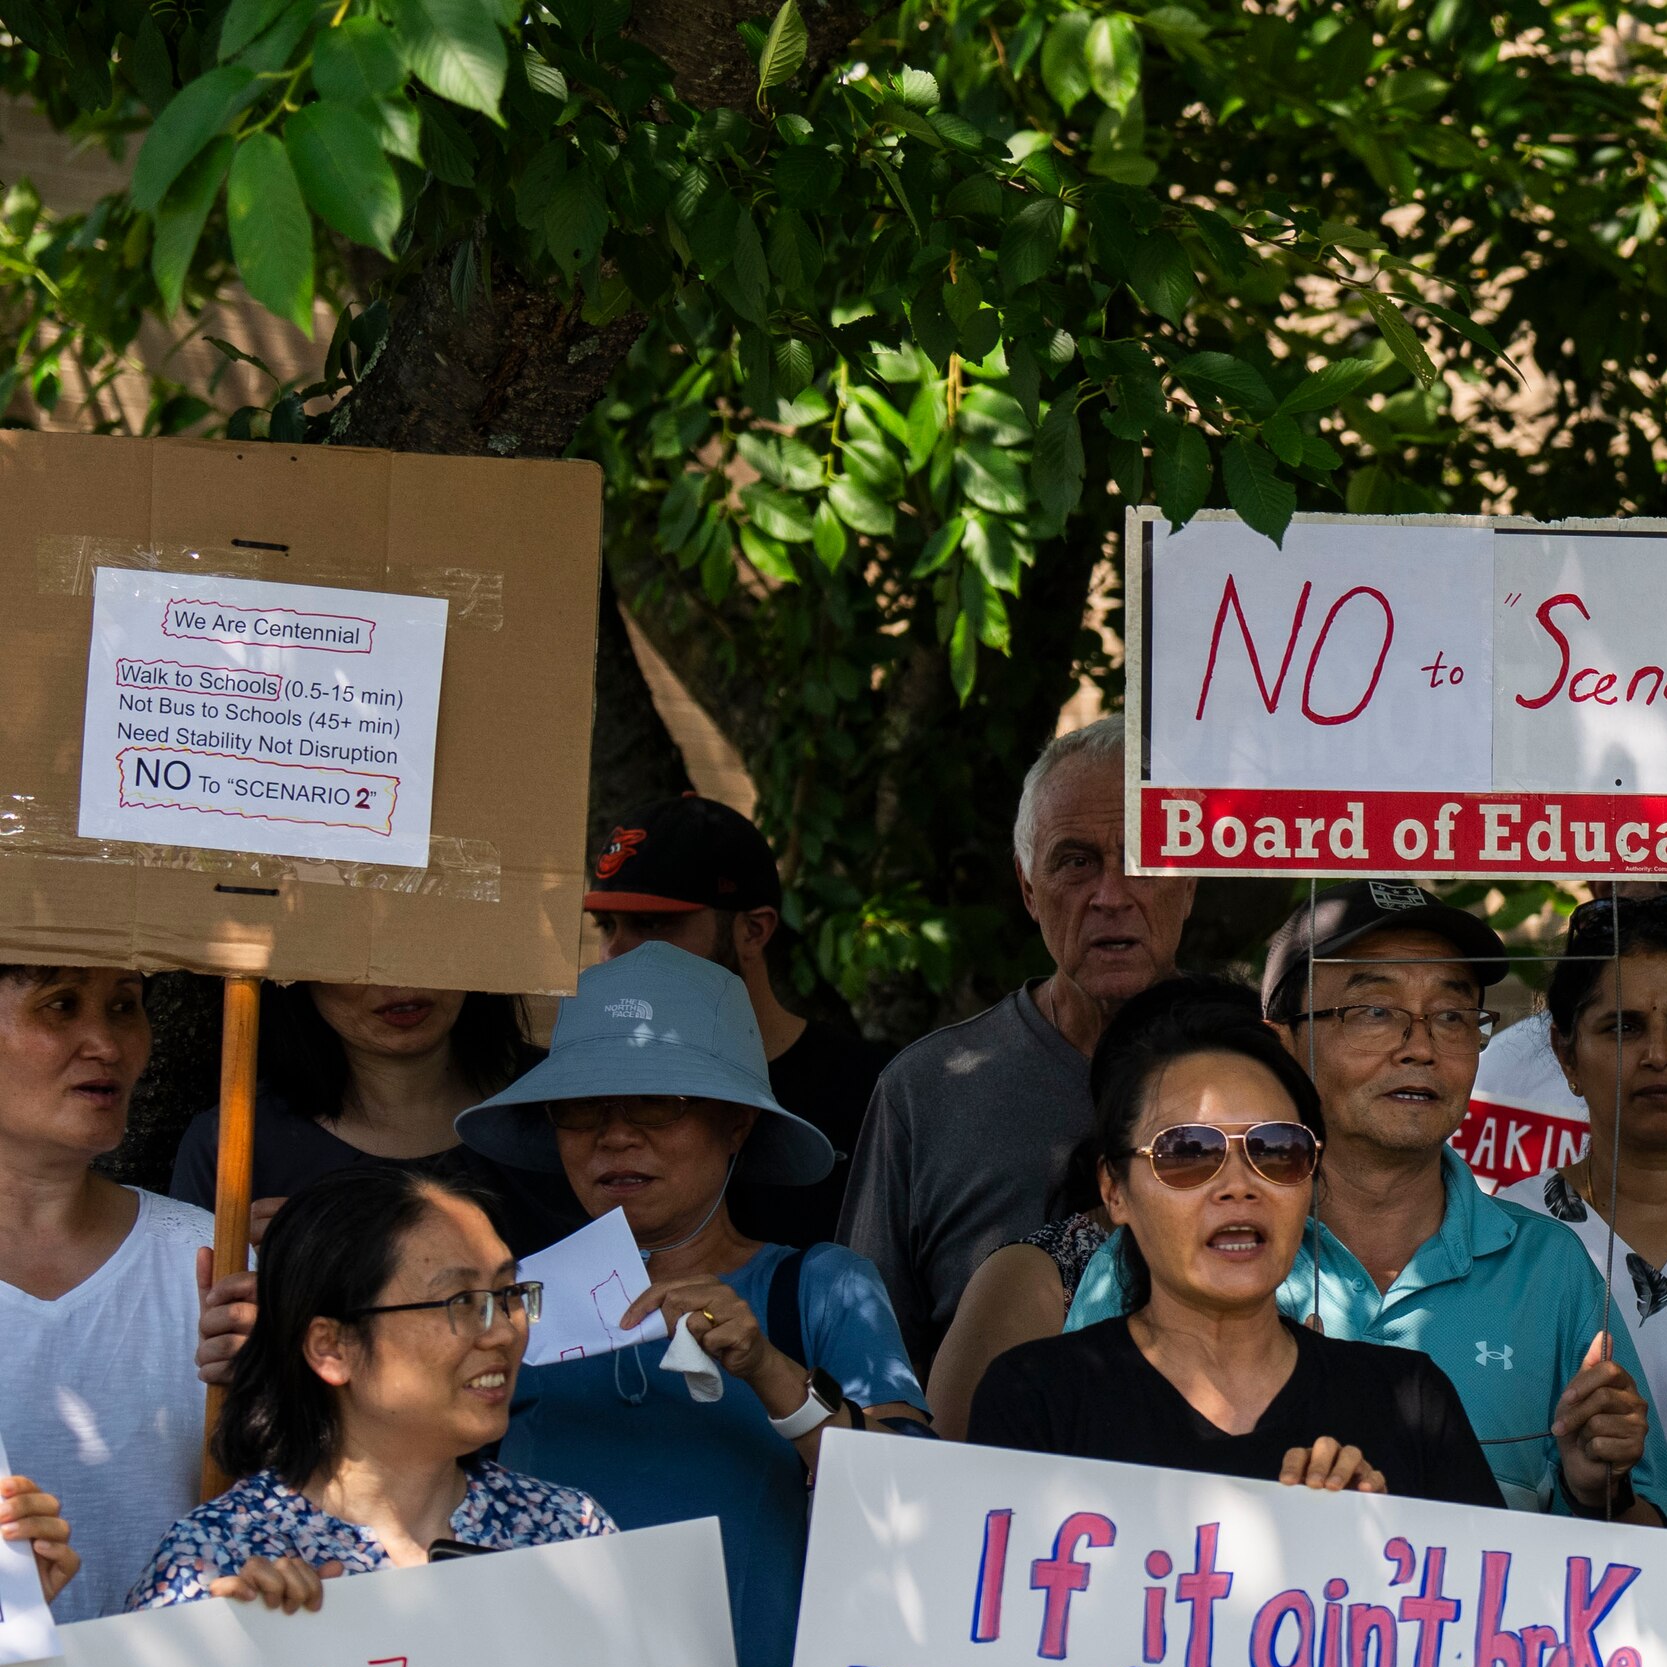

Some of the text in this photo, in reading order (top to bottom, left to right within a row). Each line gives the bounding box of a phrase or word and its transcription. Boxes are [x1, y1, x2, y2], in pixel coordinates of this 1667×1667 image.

[175, 610, 360, 645] We Are Centennial
[1196, 574, 1395, 726] NO
[1421, 651, 1465, 689] to
[121, 664, 404, 712] Walk to Schools (0.5-15 min)
[119, 693, 401, 739] Not Bus to Schools (45+ min)
[117, 722, 398, 770] Need Stability Not Disruption
[135, 757, 192, 791] NO
[199, 775, 221, 794] To
[1160, 799, 1369, 860] Board
[1392, 801, 1462, 861] of
[604, 1004, 637, 1013] NORTH
[970, 1507, 1117, 1660] If
